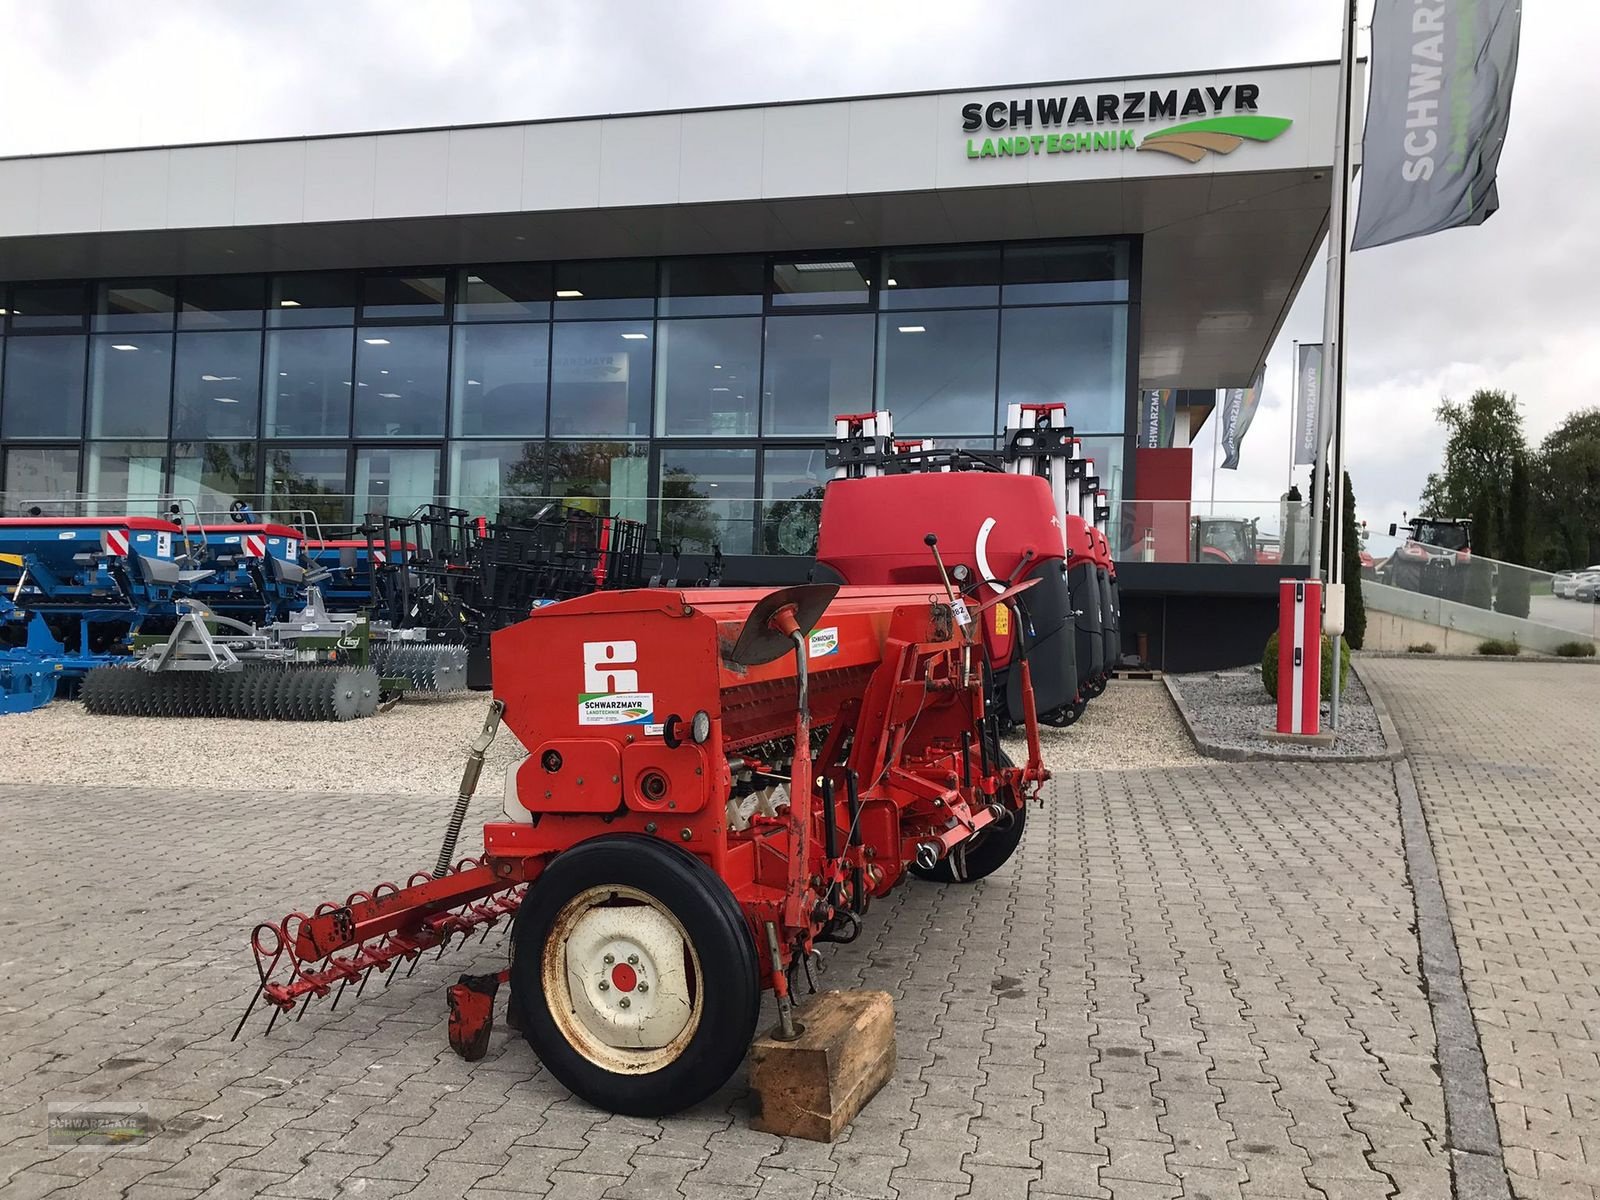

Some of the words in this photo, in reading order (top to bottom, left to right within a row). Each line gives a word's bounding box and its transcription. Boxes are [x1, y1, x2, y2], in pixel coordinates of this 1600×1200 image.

[962, 83, 1260, 132] SCHWARZMAYR
[1402, 0, 1446, 182] SCHWAR
[966, 129, 1136, 159] LANDTECHNIK
[1148, 389, 1160, 449] CHWARZMA
[1304, 367, 1317, 450] SCHWARZMAYR
[585, 701, 642, 709] SCHWARZMAYR
